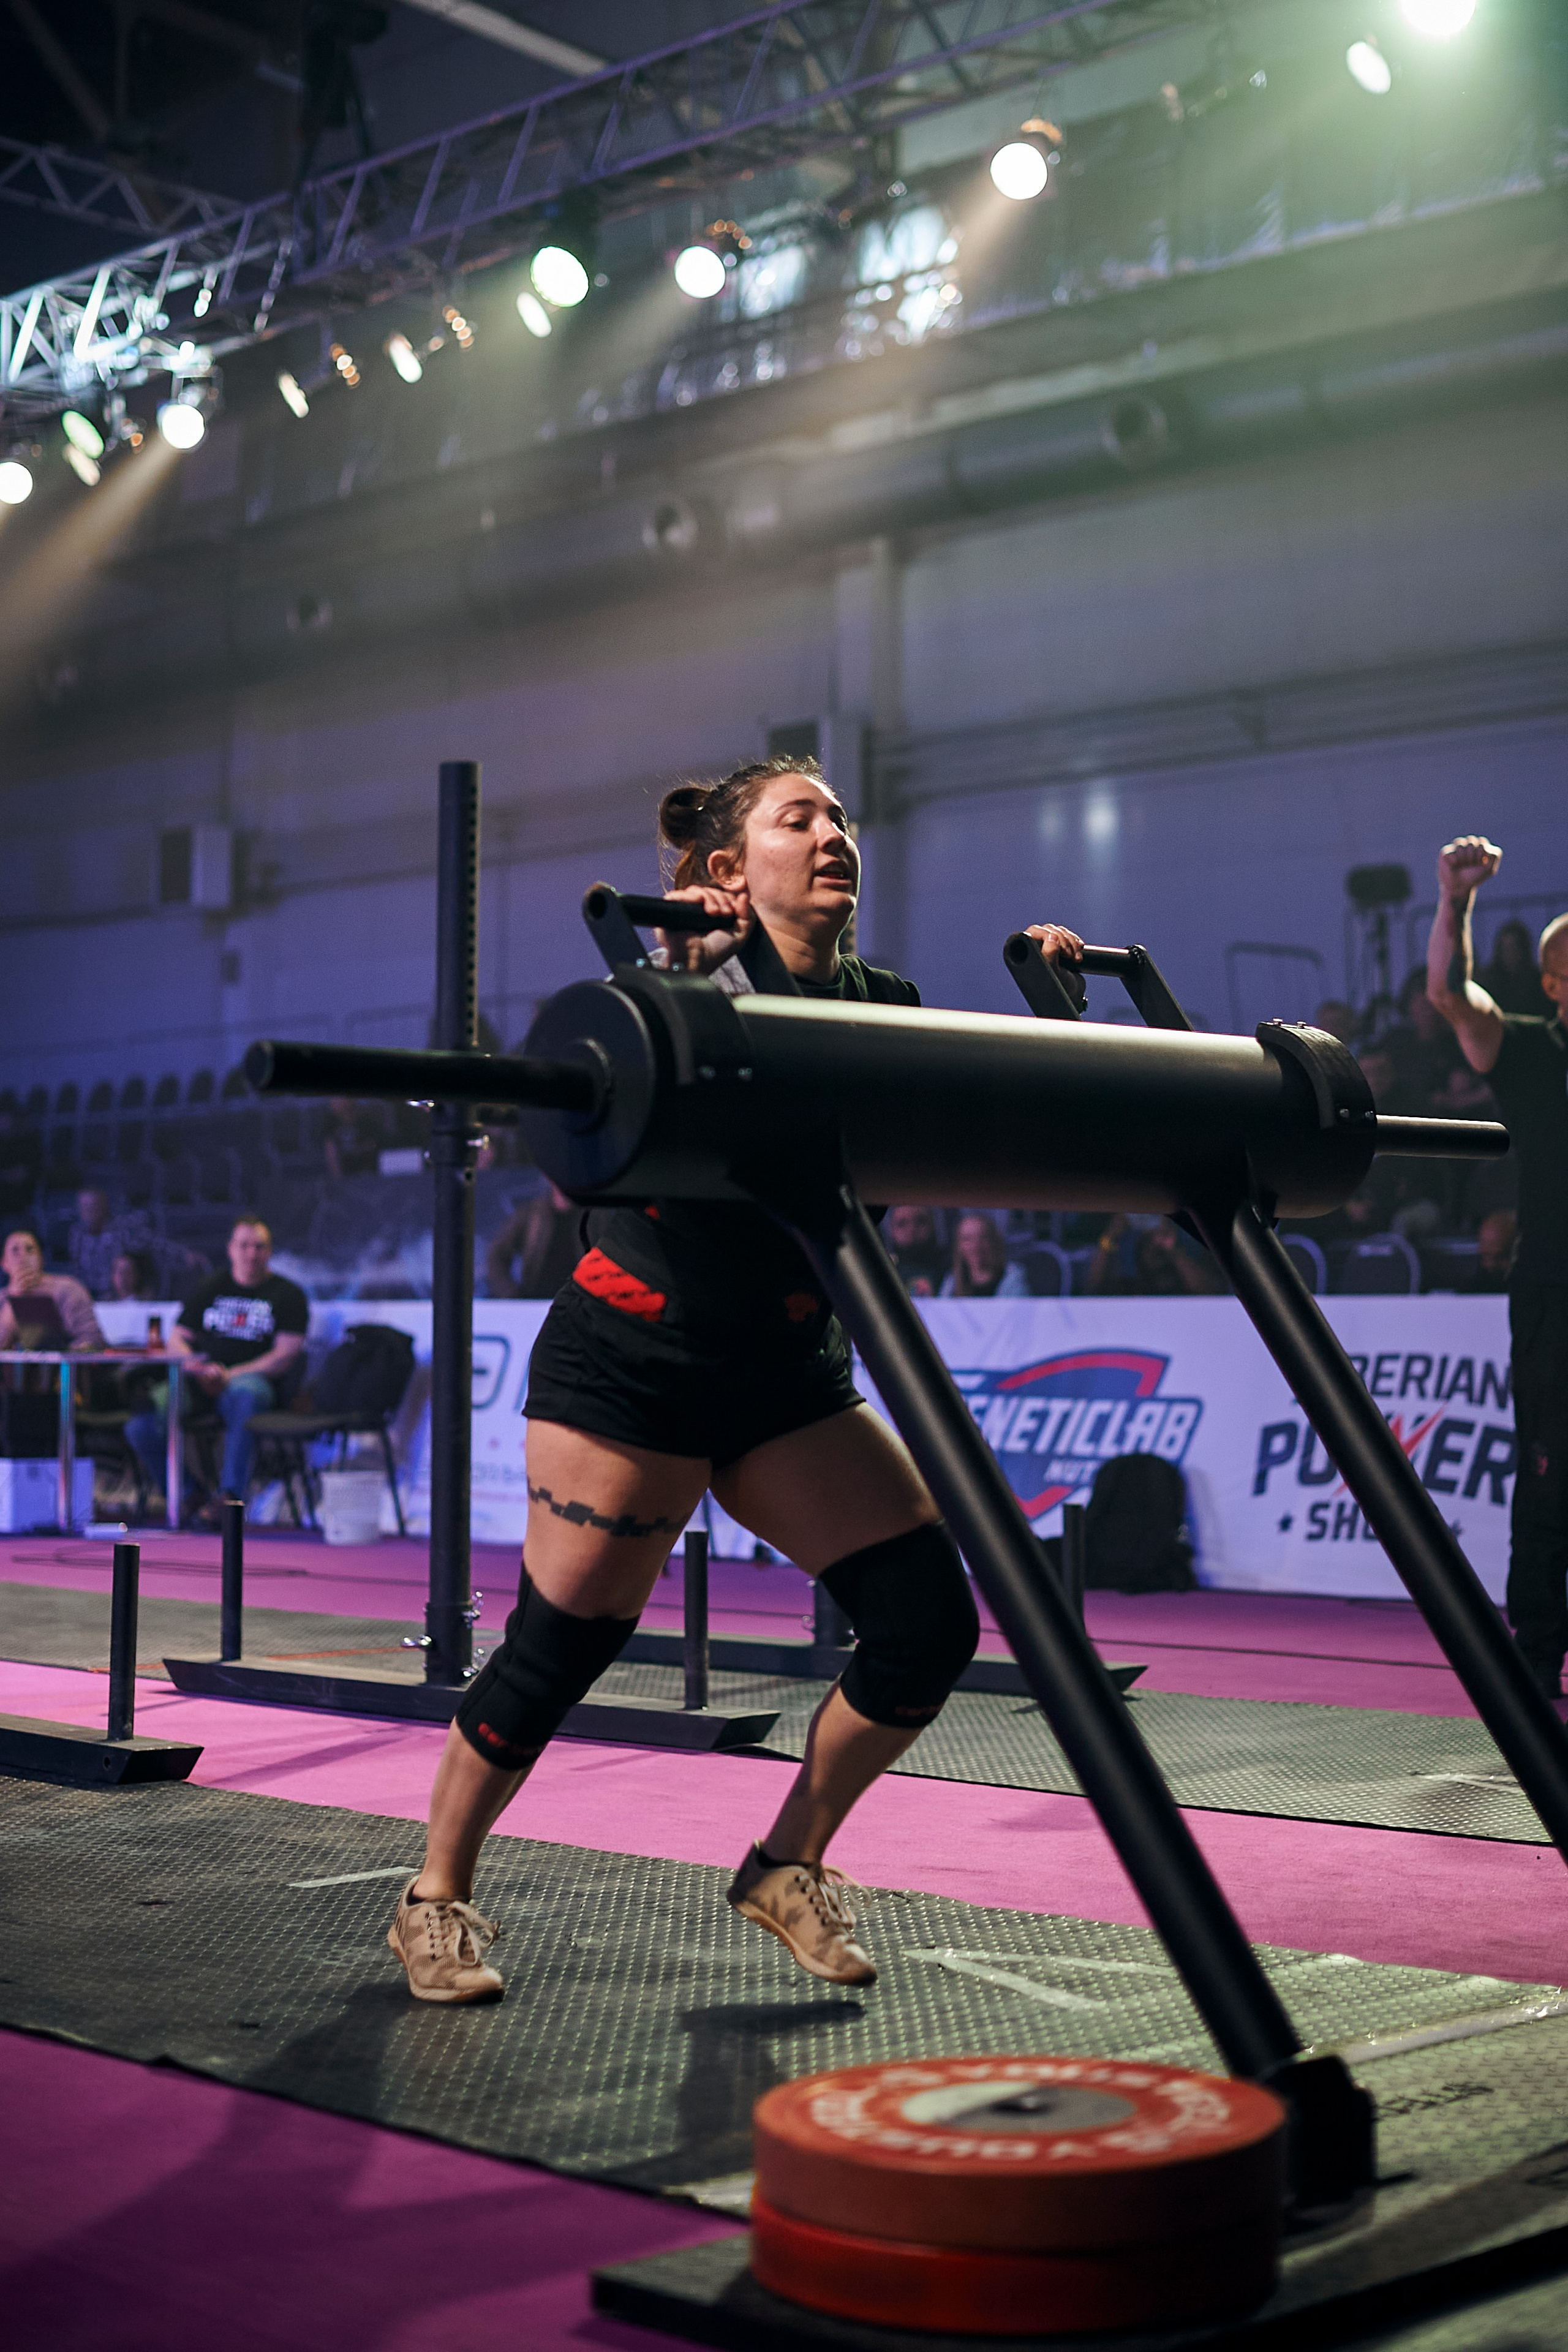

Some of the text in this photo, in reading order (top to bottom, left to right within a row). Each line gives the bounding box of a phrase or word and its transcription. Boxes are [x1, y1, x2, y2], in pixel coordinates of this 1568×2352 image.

[1349, 1353, 1511, 1411] ERIAN
[964, 1395, 1198, 1459] NETICLAB
[1252, 1415, 1518, 1507] POER
